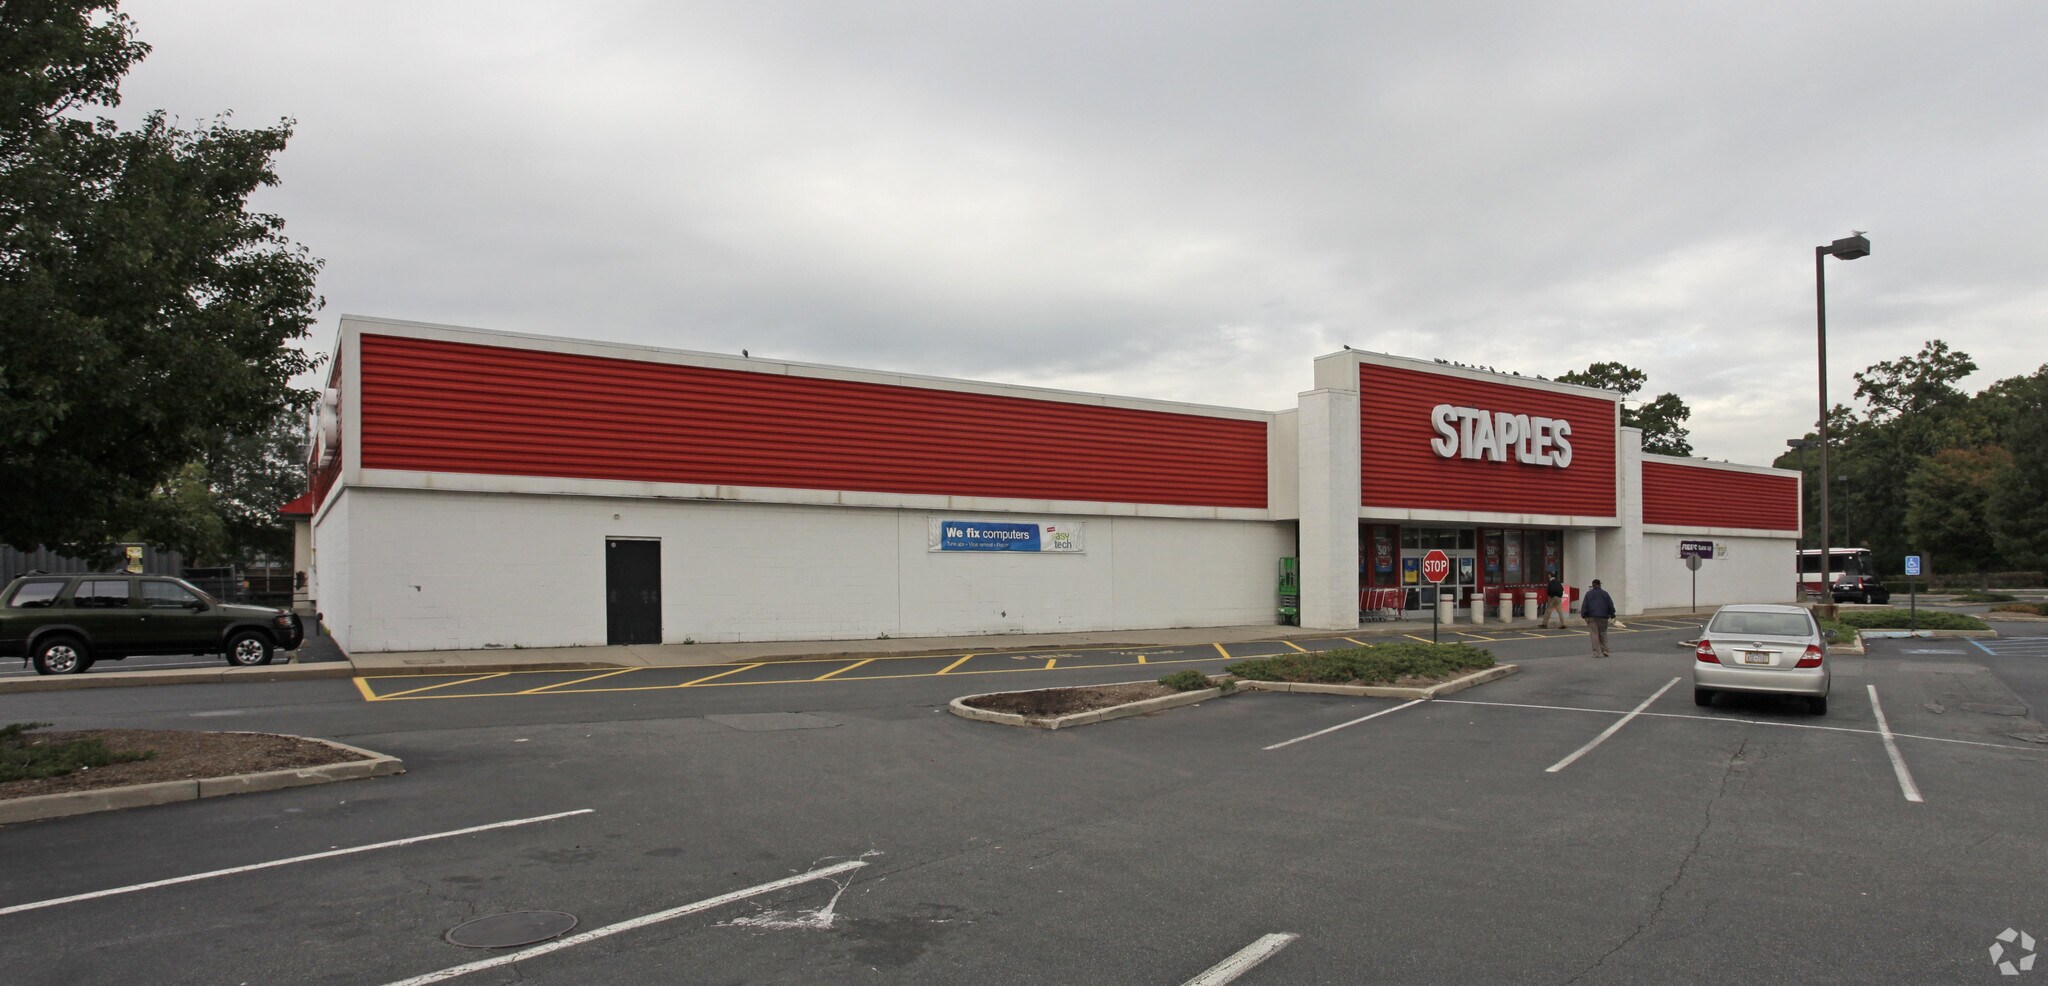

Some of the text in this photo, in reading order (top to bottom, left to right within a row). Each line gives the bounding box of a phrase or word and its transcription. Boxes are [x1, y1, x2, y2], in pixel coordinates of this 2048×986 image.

[1431, 404, 1572, 468] STAPLES
[946, 527, 1029, 541] We fix computers
[1054, 540, 1072, 549] tech
[1425, 560, 1447, 572] STOP
